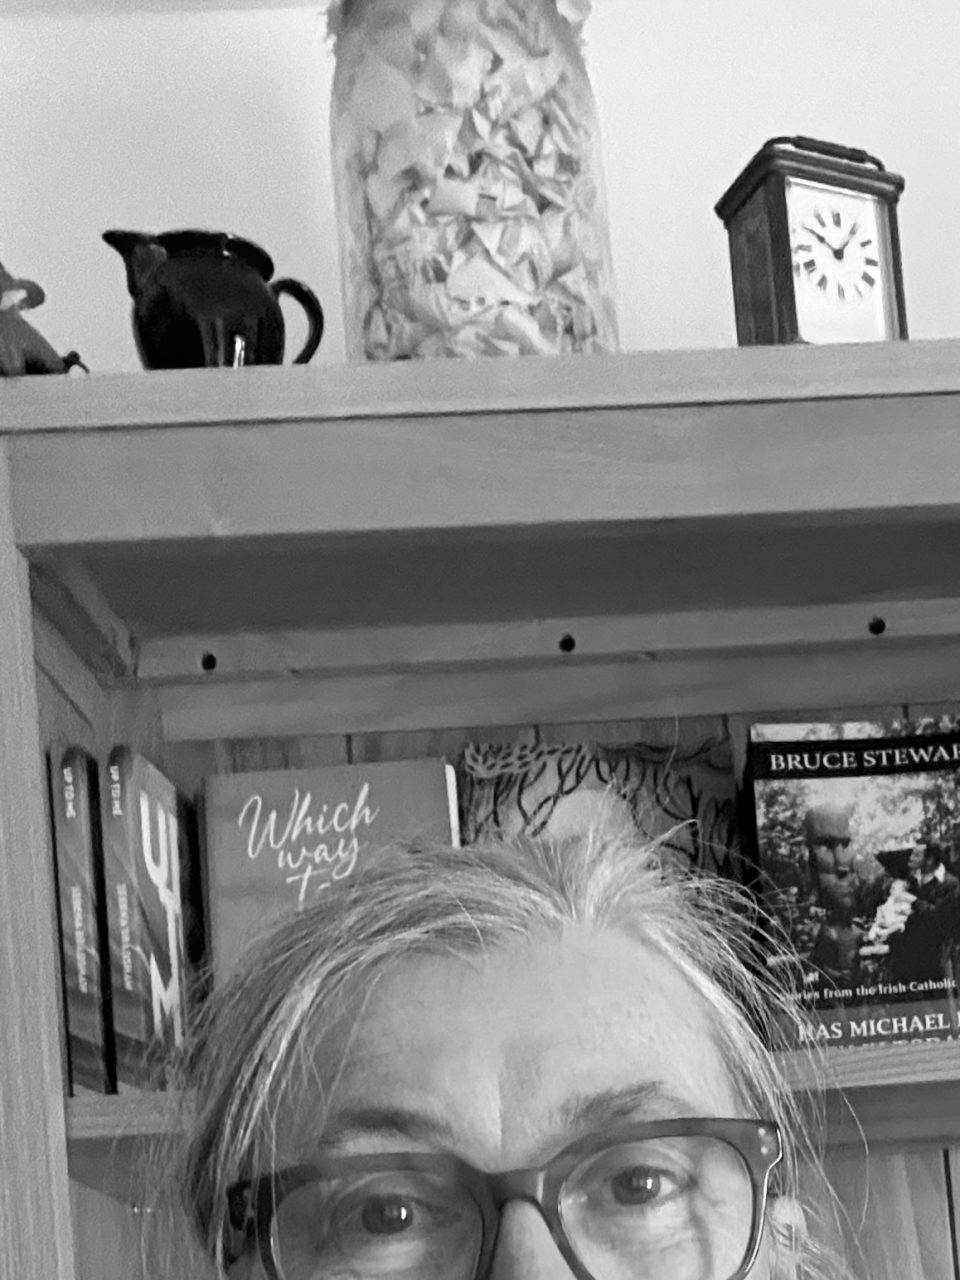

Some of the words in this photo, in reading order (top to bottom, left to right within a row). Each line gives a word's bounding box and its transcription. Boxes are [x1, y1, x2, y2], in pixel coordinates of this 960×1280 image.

[769, 752, 858, 771] BRUCE
[238, 782, 381, 859] Which
[278, 837, 359, 881] way
[823, 988, 853, 1000] from
[856, 983, 876, 997] the
[878, 983, 907, 995] Irish
[910, 979, 956, 992] Catholic
[850, 1013, 951, 1037] MICHAEL
